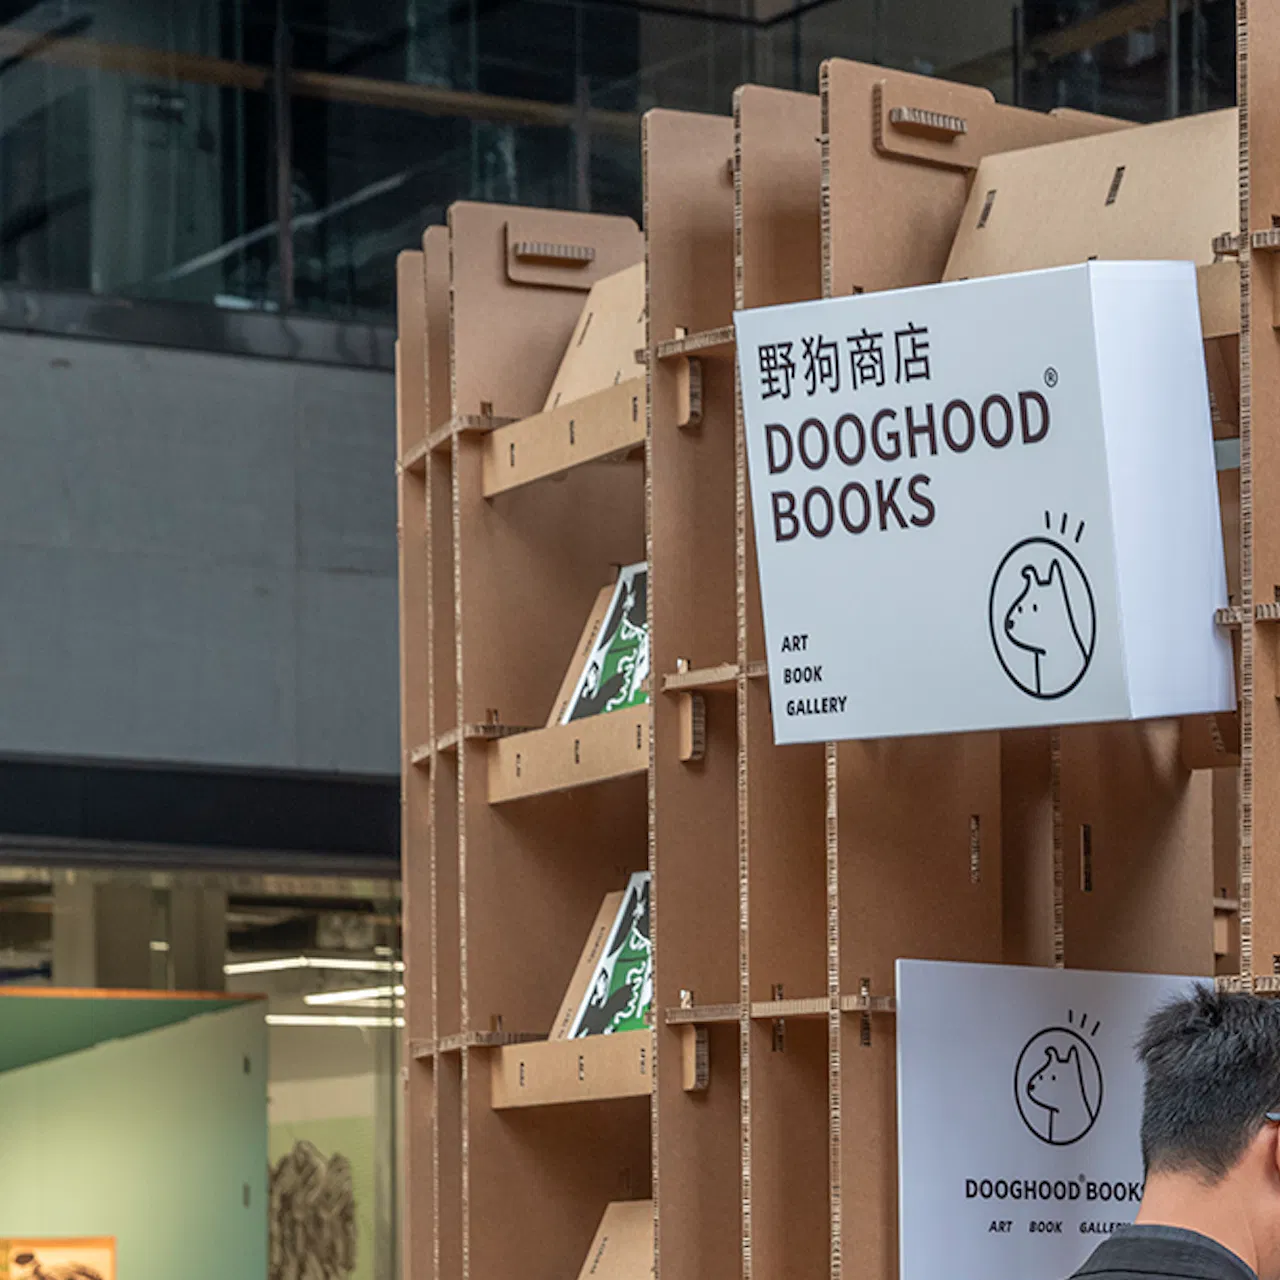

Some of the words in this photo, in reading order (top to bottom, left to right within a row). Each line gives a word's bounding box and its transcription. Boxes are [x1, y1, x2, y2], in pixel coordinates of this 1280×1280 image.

[758, 322, 931, 400] 野狗商店
[770, 474, 936, 543] BOOKS
[781, 634, 808, 653] ART
[783, 666, 823, 684] BOOK
[786, 696, 847, 716] GALLERY
[965, 1179, 1081, 1200] DOOGHOOD
[1086, 1181, 1144, 1202] BOOK
[988, 1220, 1013, 1233] ART
[1028, 1221, 1063, 1233] BOOK
